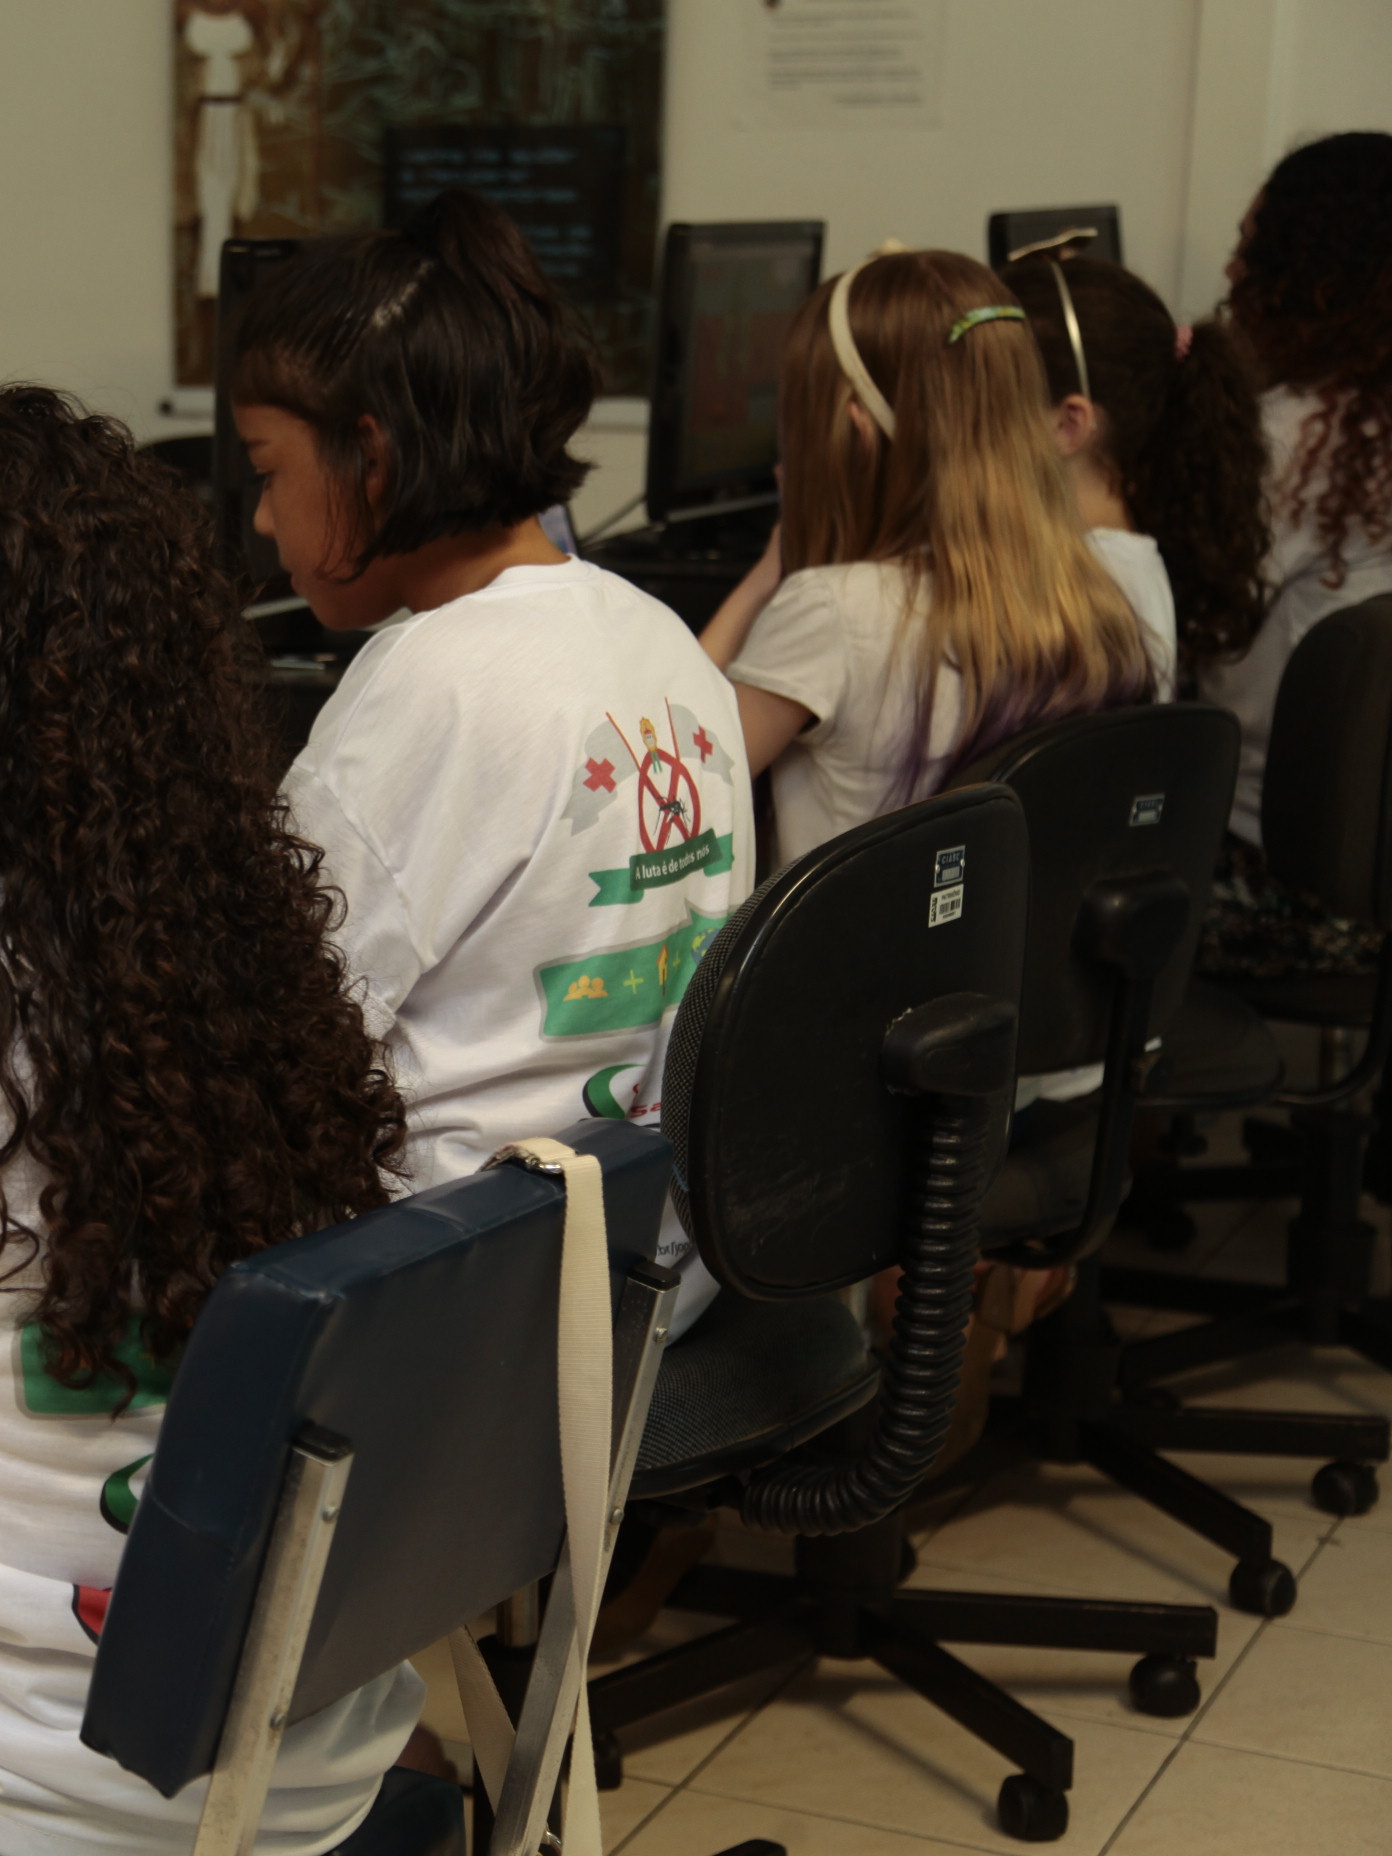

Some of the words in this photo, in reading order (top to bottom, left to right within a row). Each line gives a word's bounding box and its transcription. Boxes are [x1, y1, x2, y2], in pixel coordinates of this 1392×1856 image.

[635, 867, 641, 880] A
[642, 865, 661, 879] luta
[662, 861, 668, 875] é
[668, 859, 679, 873] de
